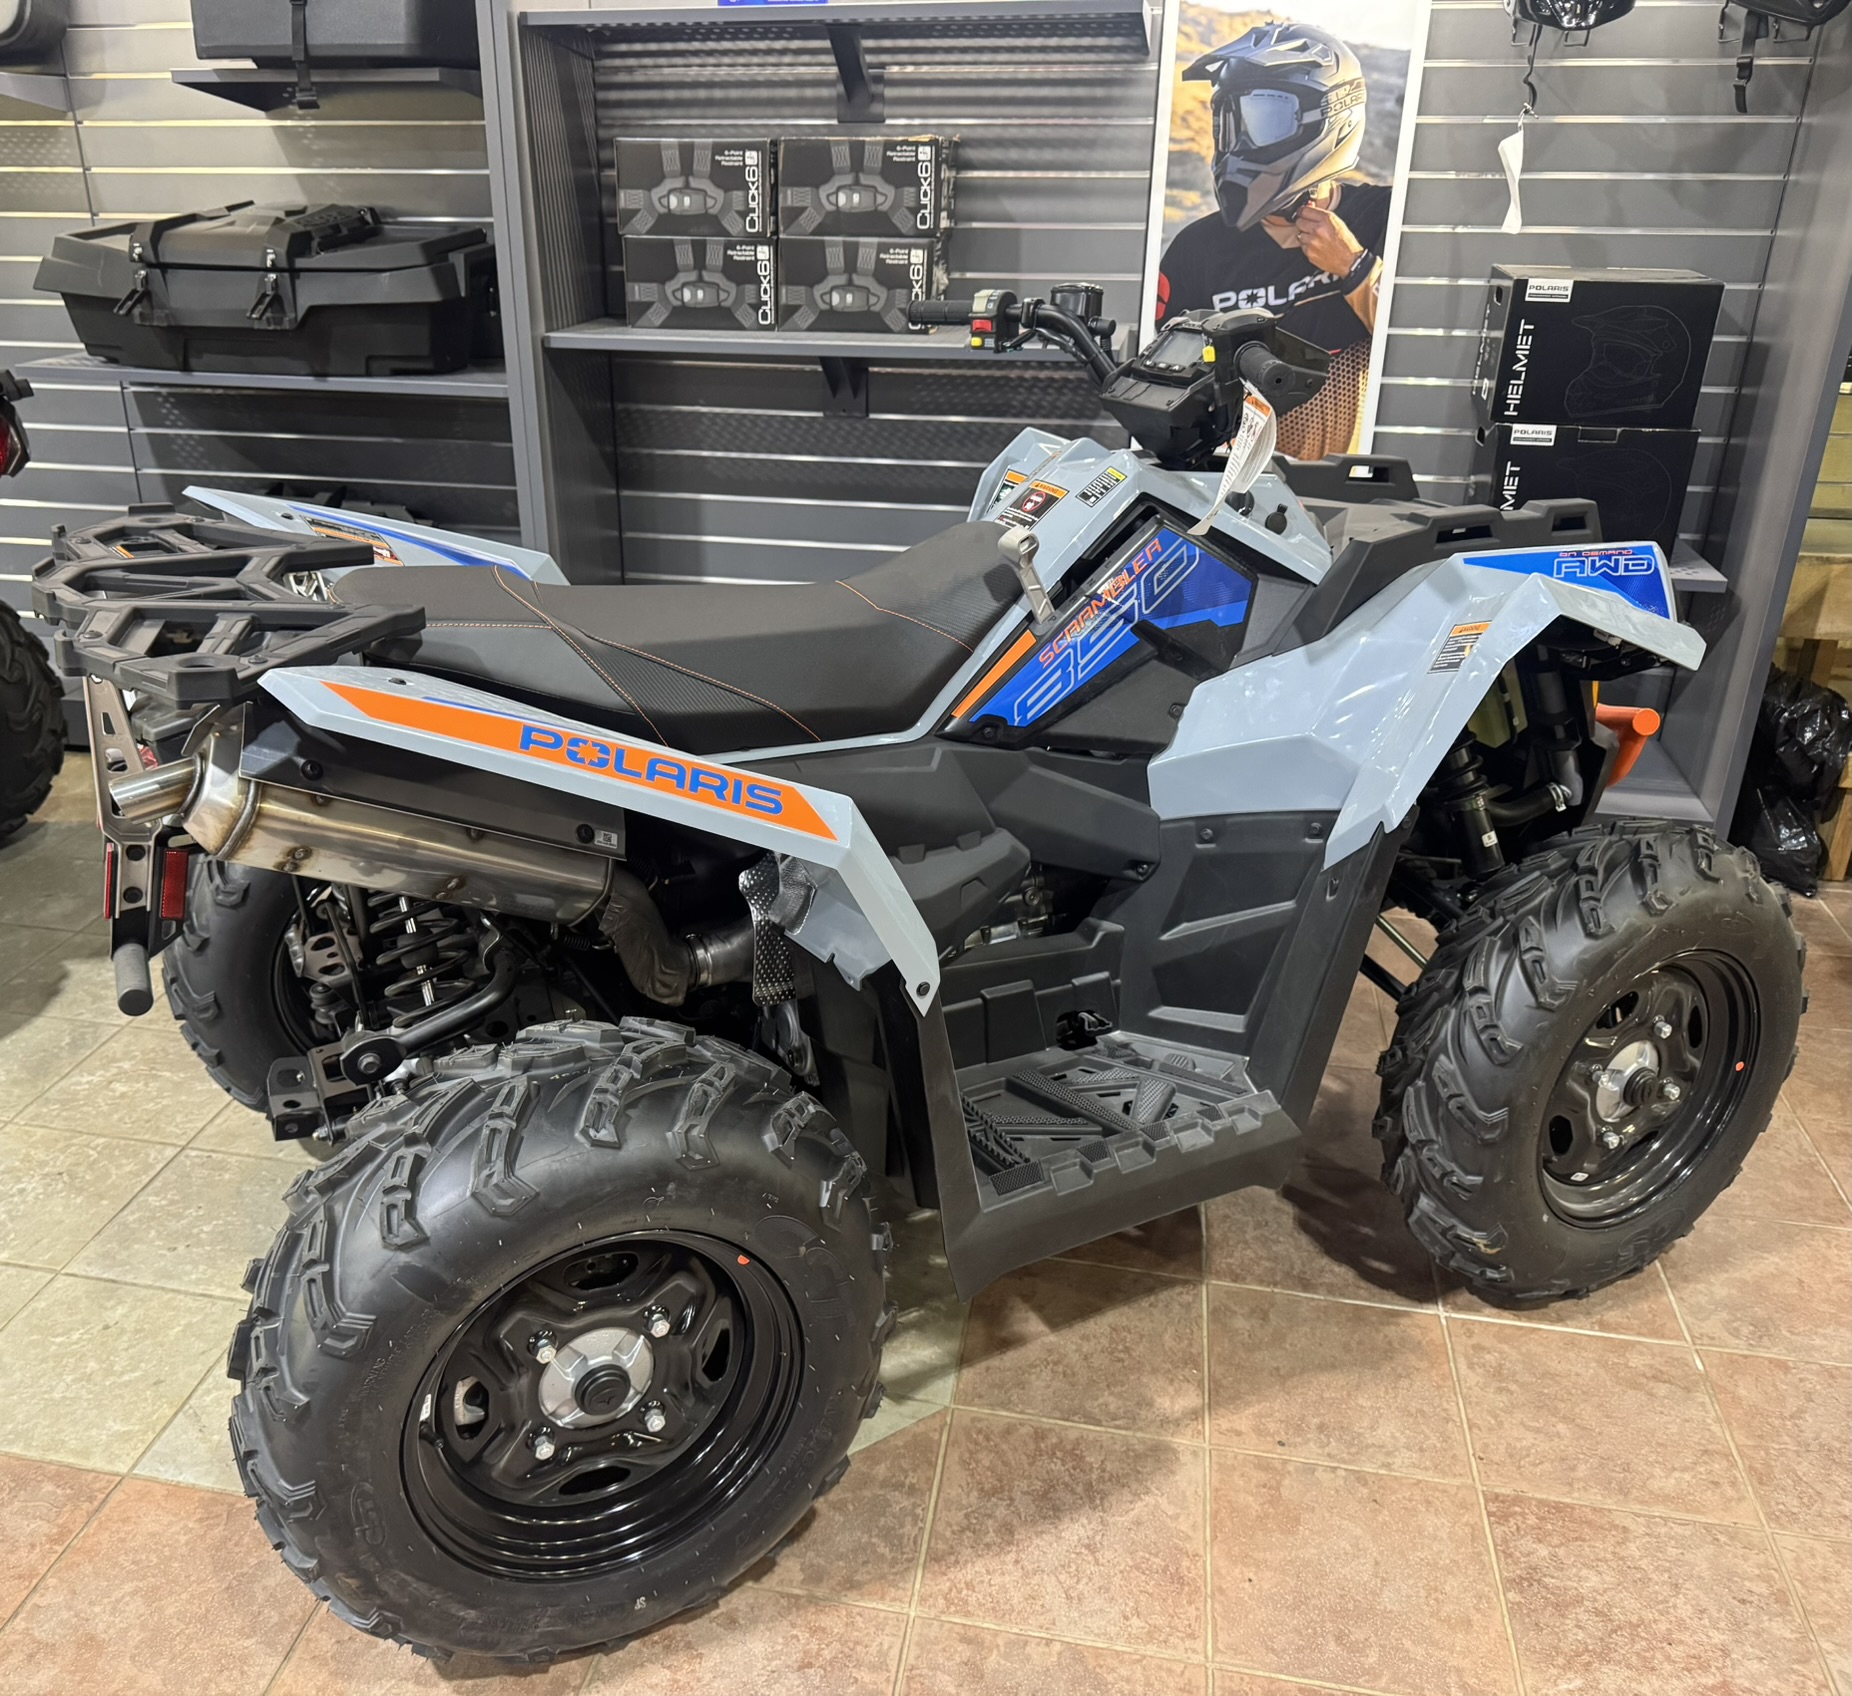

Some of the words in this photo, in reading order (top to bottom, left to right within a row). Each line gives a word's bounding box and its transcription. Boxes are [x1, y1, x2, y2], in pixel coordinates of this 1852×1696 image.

[1529, 284, 1569, 292] POLARIS
[1504, 319, 1535, 416] HELMET
[1514, 428, 1553, 436] POLARIS
[1499, 460, 1521, 511] MET
[1553, 554, 1655, 578] AWD
[1014, 537, 1200, 726] 850
[1039, 538, 1163, 669] SCRAMBLER
[519, 724, 783, 815] POLARIS
